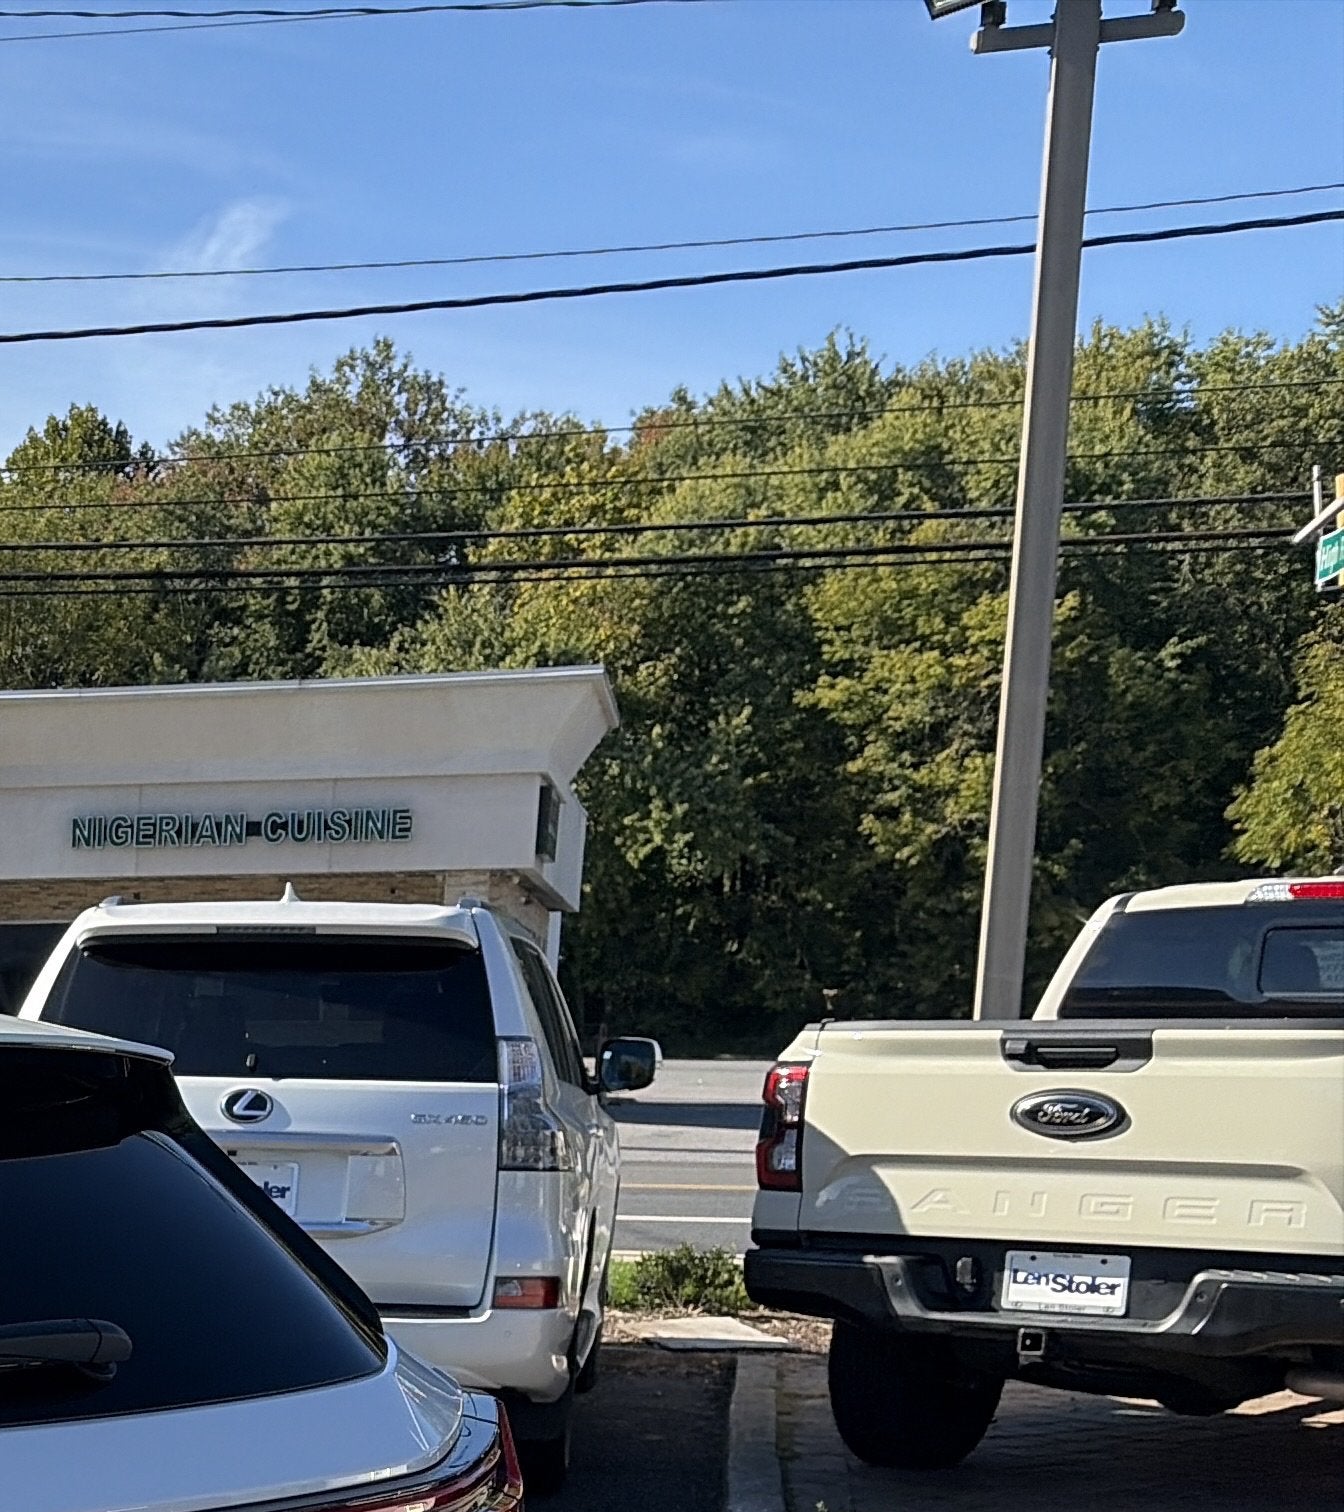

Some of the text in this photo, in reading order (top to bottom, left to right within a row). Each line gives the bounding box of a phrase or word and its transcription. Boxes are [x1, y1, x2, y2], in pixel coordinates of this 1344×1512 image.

[70, 807, 413, 850] NIGERIAN CUISINE
[1037, 1102, 1091, 1124] Ford
